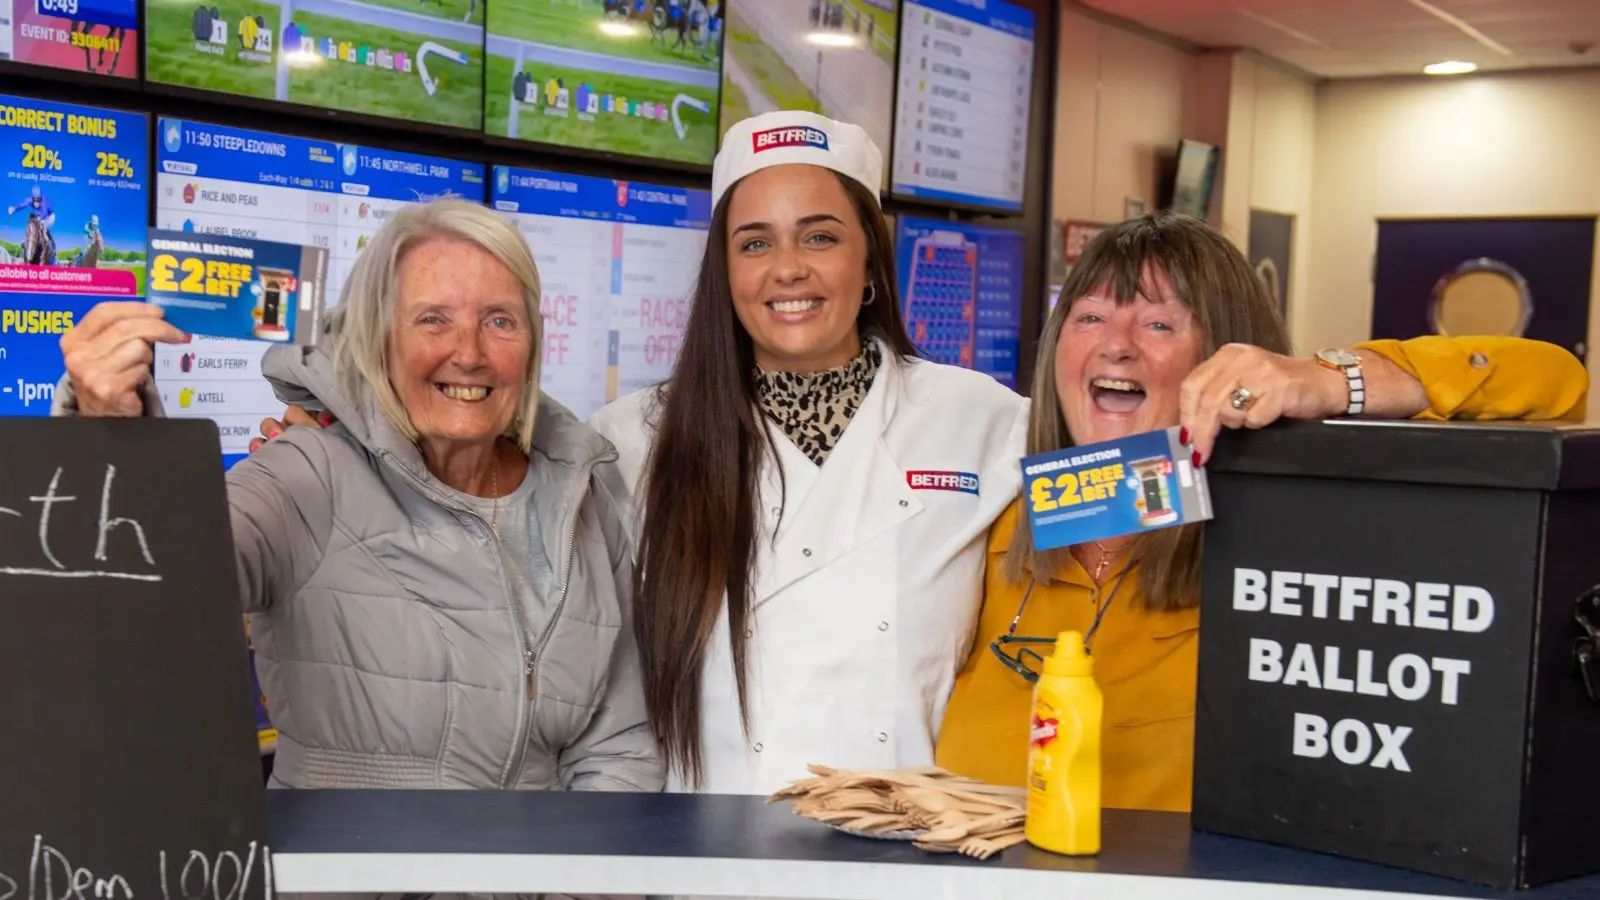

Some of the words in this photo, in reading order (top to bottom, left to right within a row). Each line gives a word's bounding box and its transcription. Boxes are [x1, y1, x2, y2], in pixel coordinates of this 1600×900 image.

[20, 23, 55, 41] EVENT
[56, 28, 70, 44] ID:
[259, 33, 270, 46] 14
[0, 105, 64, 132] CORRECT
[67, 114, 117, 139] BONUS
[185, 130, 211, 147] 11:50
[213, 138, 286, 157] STEEPLEDOWNS
[757, 129, 825, 148] BETFRED
[22, 143, 62, 170] 20%
[96, 152, 133, 178] 25%
[360, 155, 381, 170] 11:45
[383, 159, 428, 177] NORTHWELL
[430, 165, 449, 178] PARK
[201, 190, 219, 202] RICE
[221, 193, 236, 204] AND
[238, 195, 258, 206] PEAS
[201, 225, 230, 237] LAUREL
[232, 229, 258, 240] BROOK
[151, 239, 201, 254] GENERAL
[202, 243, 254, 260] ELECTION
[29, 270, 38, 279] to
[39, 270, 49, 279] all
[50, 272, 92, 283] customers
[151, 254, 205, 294] £2
[206, 260, 252, 282] FREE
[205, 277, 243, 298] BET
[540, 294, 578, 326] ACE
[2, 310, 73, 334] PUSHES
[543, 333, 570, 365] FF
[198, 358, 222, 369] EARLS
[224, 358, 248, 370] FERRY
[17, 379, 55, 407] 1pm
[197, 392, 225, 404] AXTELL
[233, 426, 250, 436] ROW
[1025, 458, 1072, 476] GENERAL
[1071, 448, 1122, 467] ELECTION
[910, 473, 978, 490] BETFRED
[1077, 463, 1126, 487] FREE
[1030, 473, 1082, 513] £2
[1081, 481, 1118, 503] BET
[1232, 567, 1496, 634] BETFRED
[1248, 637, 1472, 706] BALLOT
[1292, 712, 1414, 773] BOX
